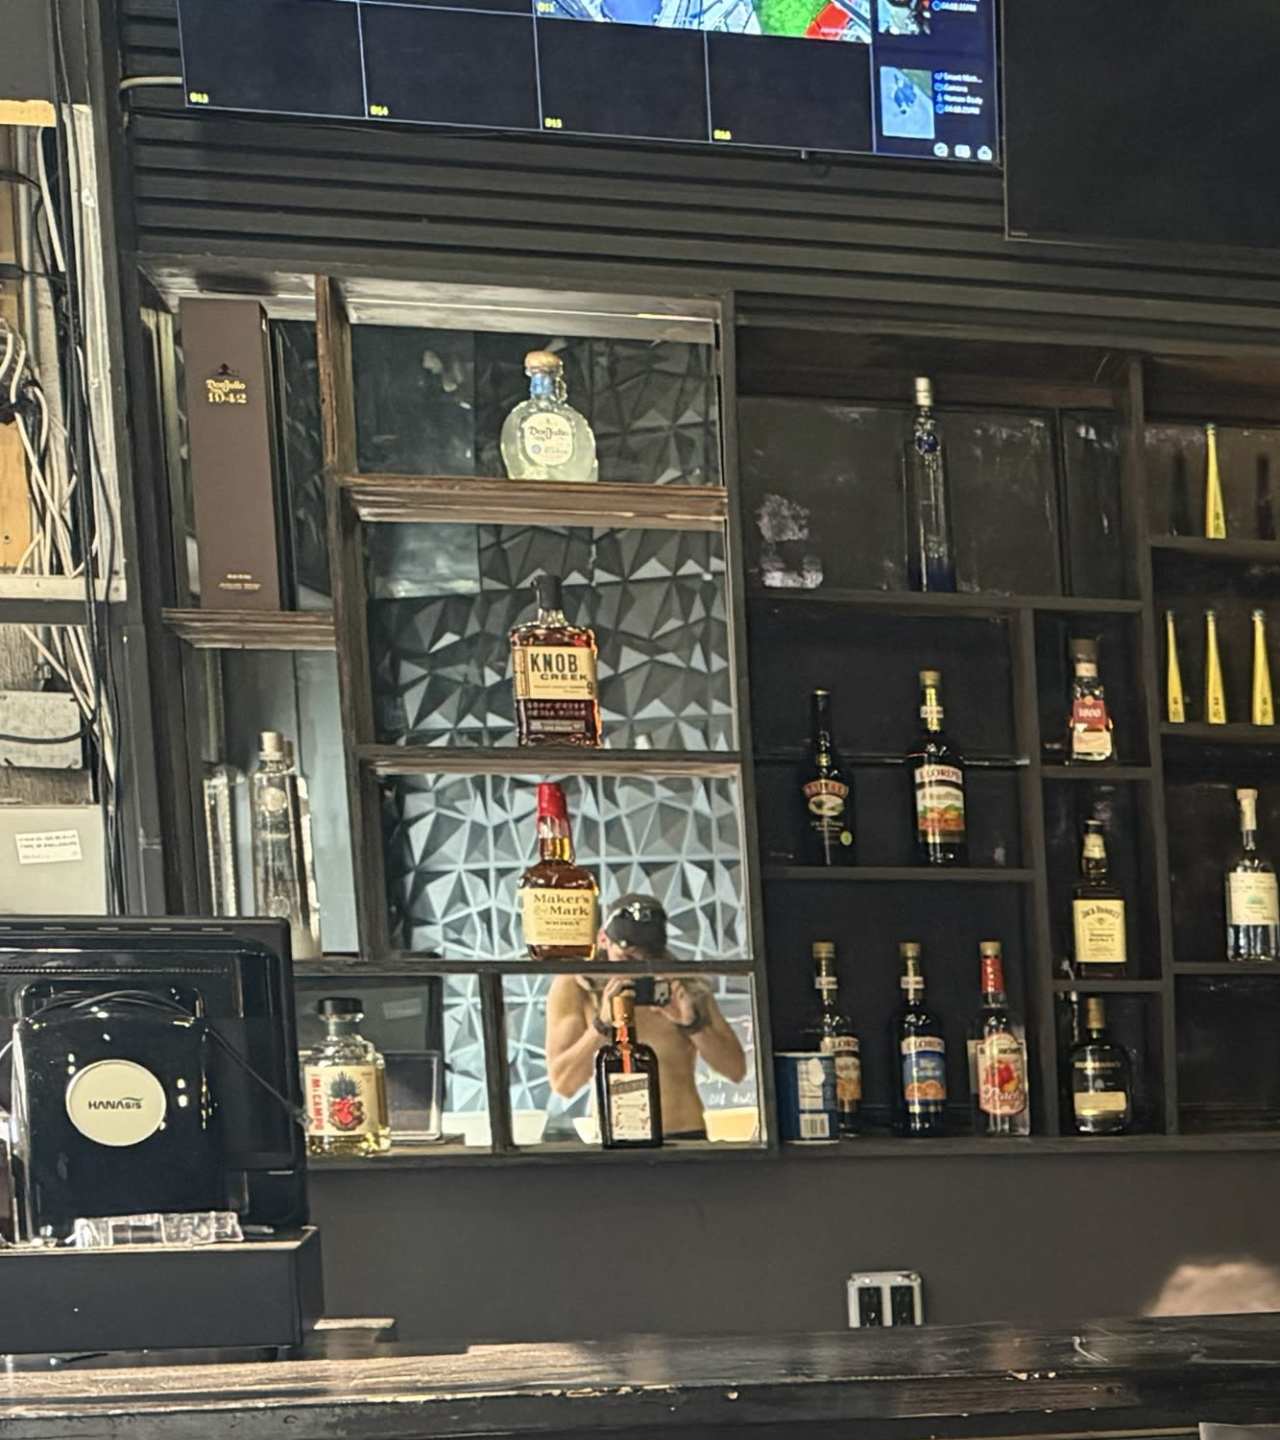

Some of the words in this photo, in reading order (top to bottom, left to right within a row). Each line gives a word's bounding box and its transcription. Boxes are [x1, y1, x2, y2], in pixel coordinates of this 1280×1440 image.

[530, 653, 578, 673] KNOB
[540, 673, 588, 681] CREEK
[533, 892, 590, 904] Maker's
[549, 904, 590, 916] Mark
